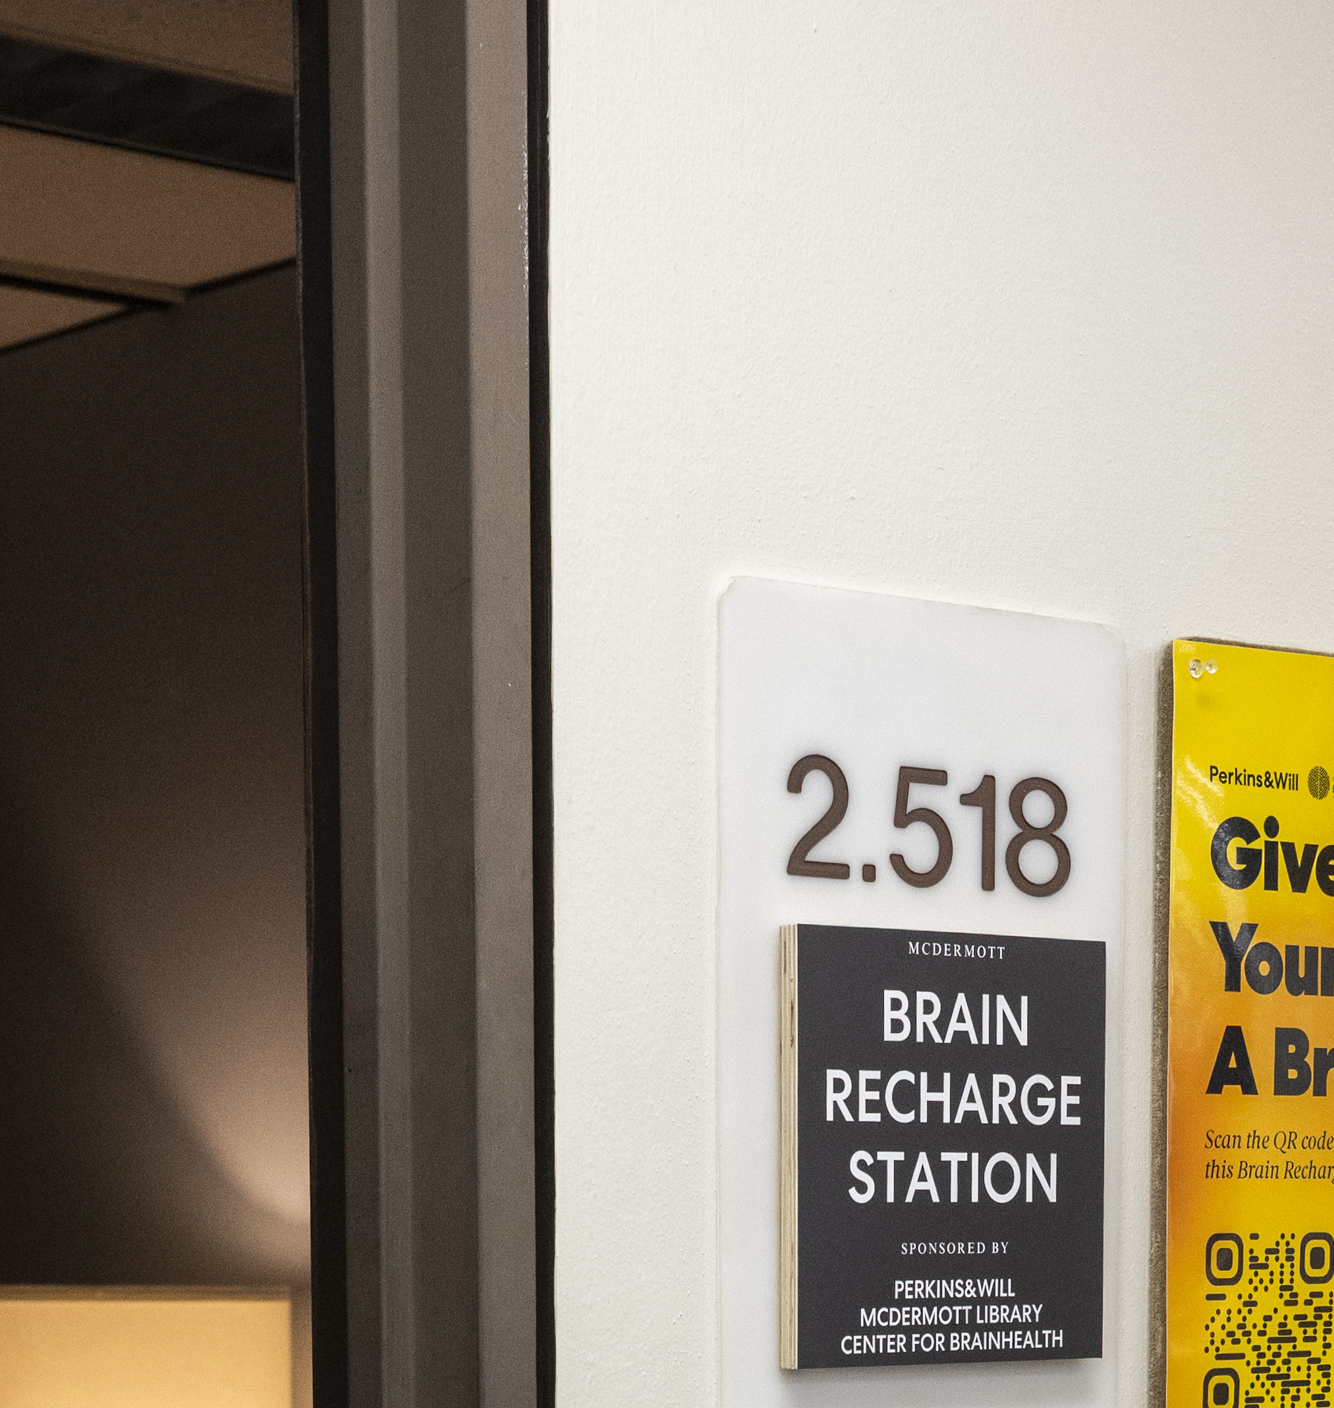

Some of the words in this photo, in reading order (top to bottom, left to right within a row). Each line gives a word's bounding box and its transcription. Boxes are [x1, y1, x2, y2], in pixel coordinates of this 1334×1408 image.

[1209, 765, 1299, 791] Perkins&Will
[786, 753, 1072, 898] 2.518
[908, 941, 1006, 960] MCDERMOTT
[883, 989, 1028, 1046] BRAIN
[1205, 1025, 1259, 1096] A
[825, 1068, 1081, 1126] RECHARGE
[1204, 1129, 1242, 1149] Scan
[1246, 1129, 1270, 1150] the
[1273, 1130, 1298, 1154] QR
[1301, 1130, 1334, 1150] code
[848, 1150, 1058, 1204] STATION
[1204, 1159, 1234, 1180] this
[1237, 1160, 1280, 1180] Brain
[901, 1241, 986, 1255] SPONSORED
[991, 1241, 1009, 1254] BY
[894, 1278, 1015, 1299] PERKINS&WILL
[860, 1305, 972, 1327] MCDERMOTT
[976, 1304, 1043, 1324] LIBRARY
[840, 1334, 907, 1355] CENTER
[911, 1332, 946, 1352] FOR
[949, 1329, 1064, 1351] BRAINHEALTH
